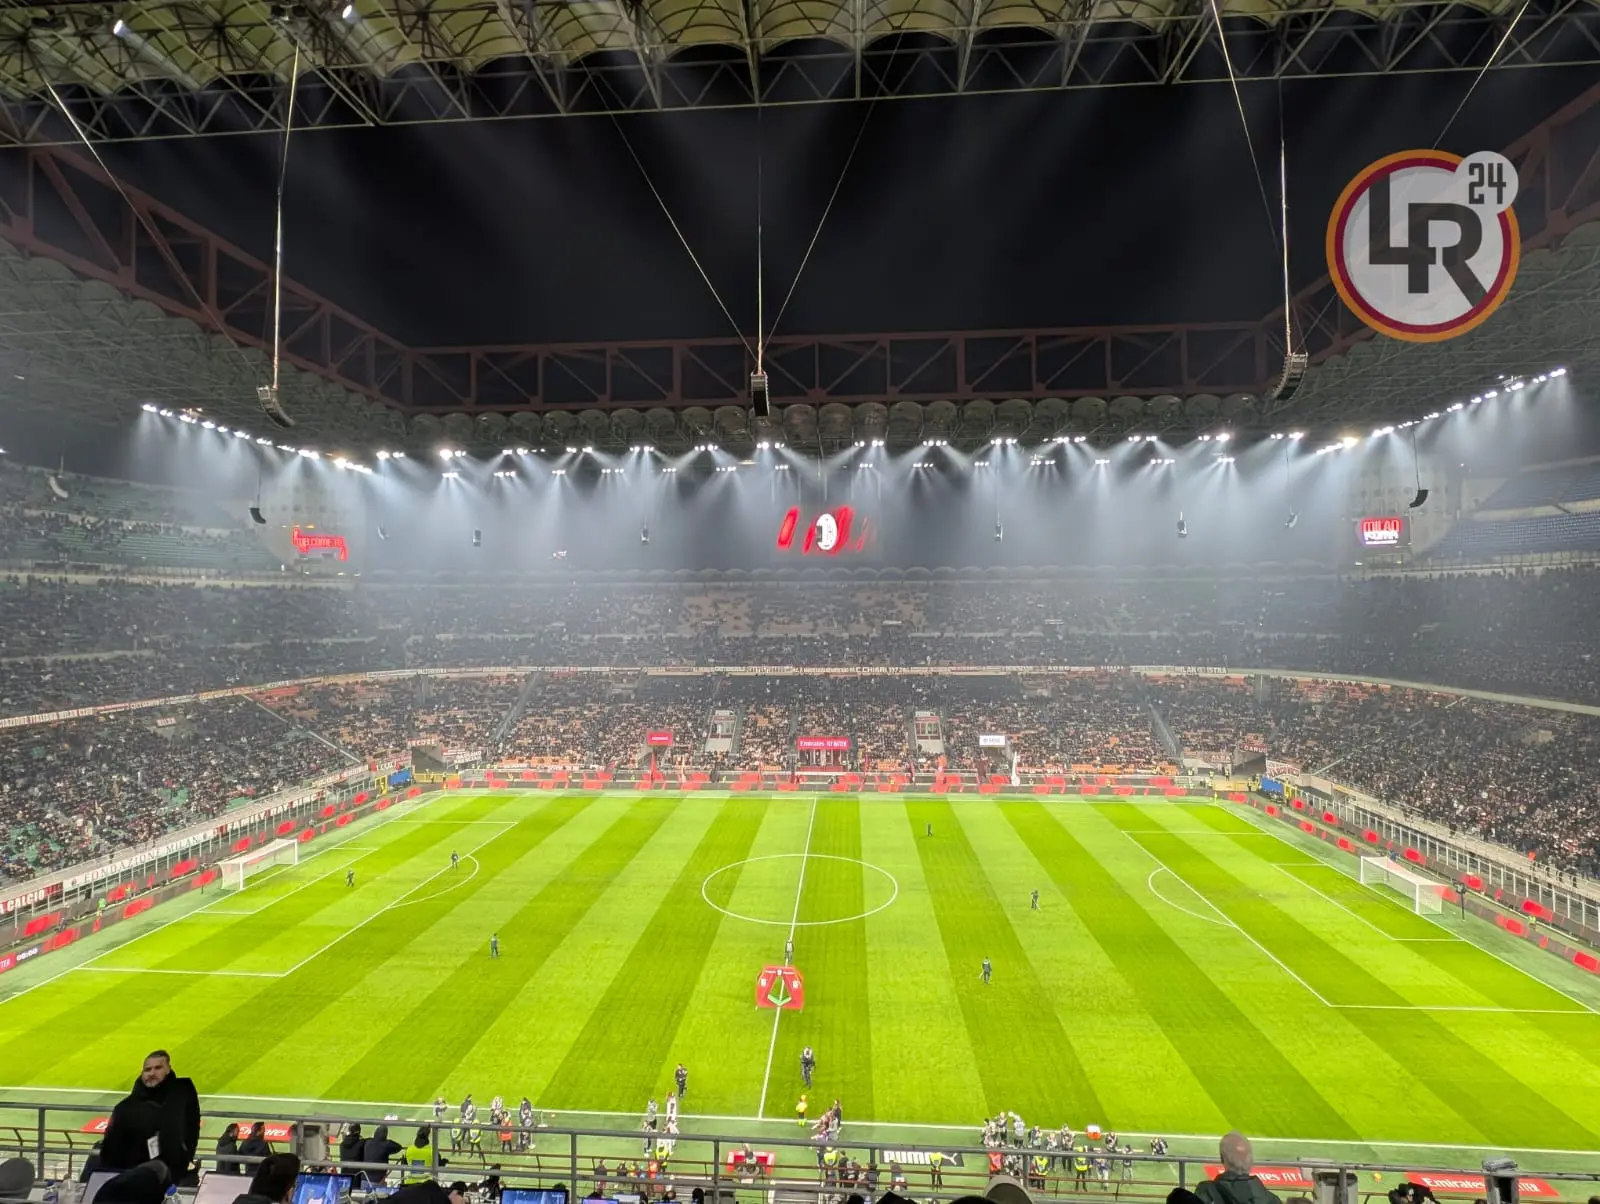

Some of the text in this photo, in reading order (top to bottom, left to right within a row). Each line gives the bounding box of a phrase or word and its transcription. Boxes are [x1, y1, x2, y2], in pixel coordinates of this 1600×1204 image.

[84, 836, 200, 882] FONDAZIONE MILAN
[7, 889, 45, 912] CALCIO
[1421, 1177, 1486, 1189] Emirates
